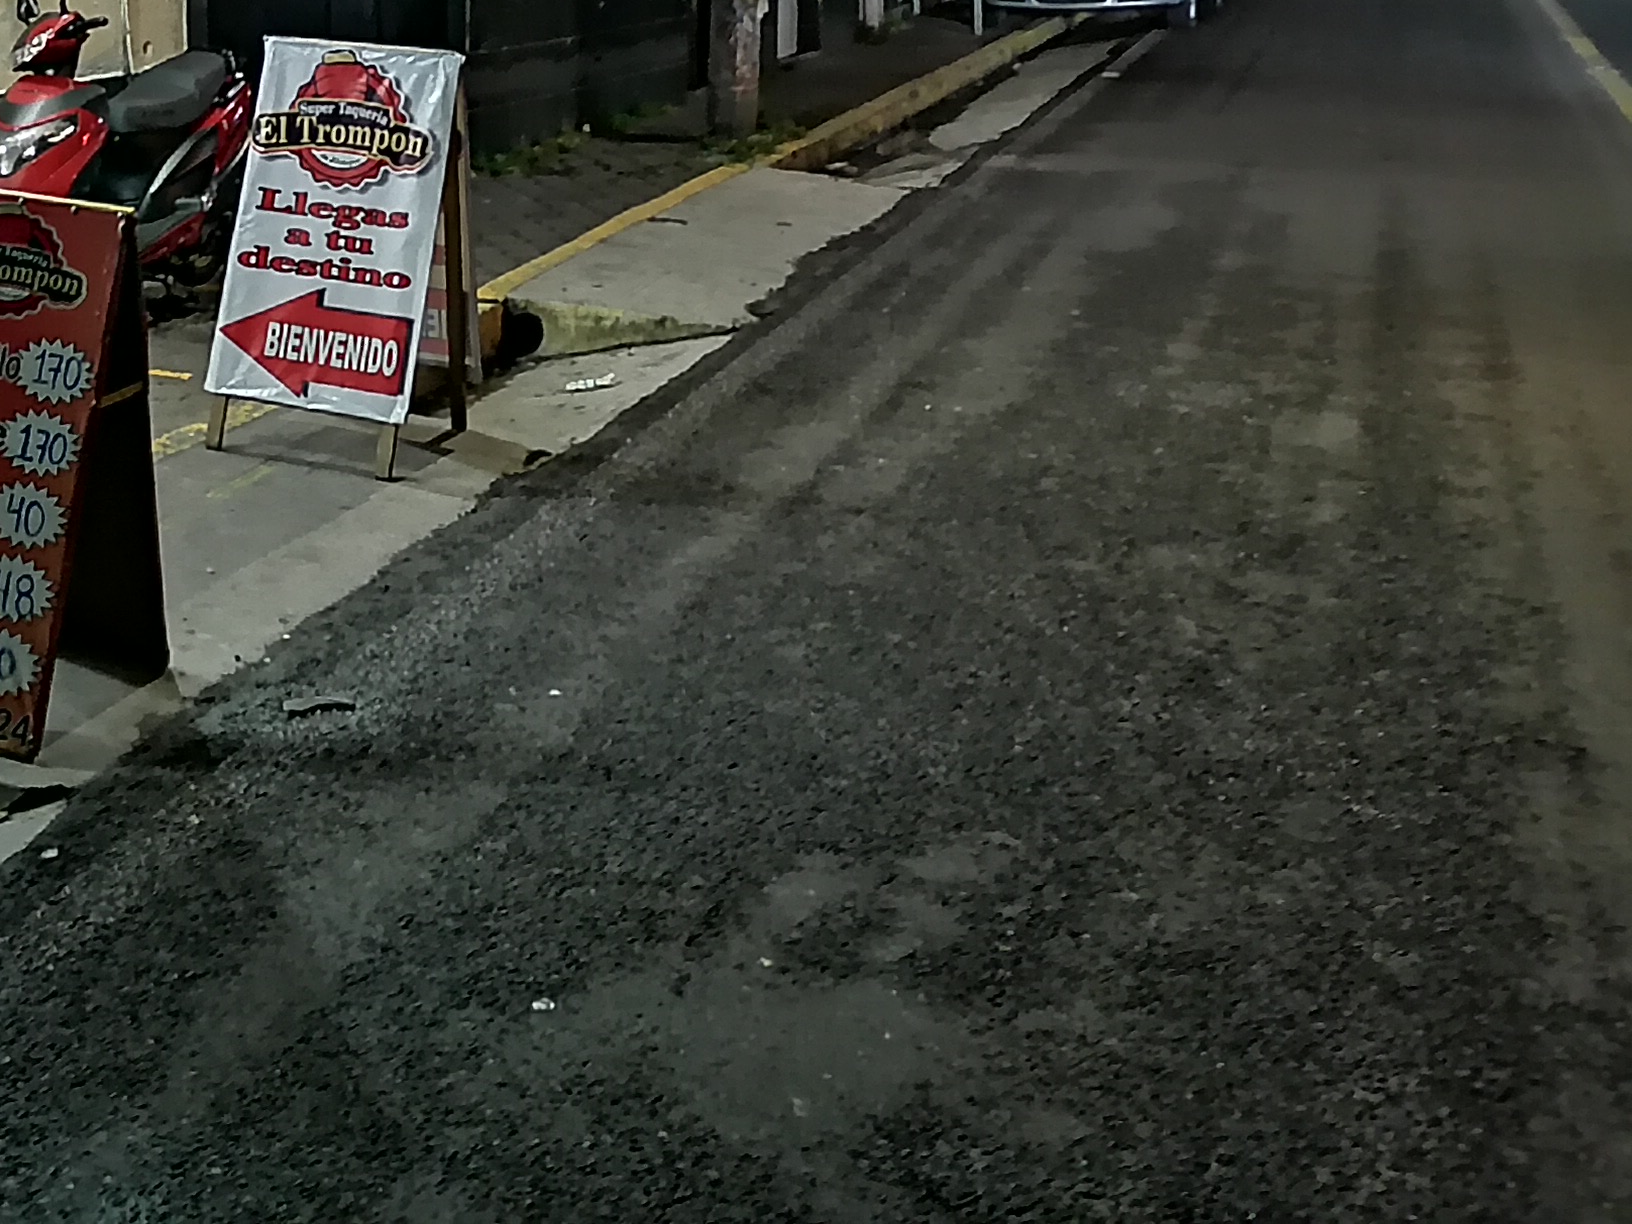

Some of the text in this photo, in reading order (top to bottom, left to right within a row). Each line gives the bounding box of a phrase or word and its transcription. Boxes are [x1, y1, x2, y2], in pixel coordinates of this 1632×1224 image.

[298, 102, 336, 117] Super
[258, 115, 423, 157] El Trompon
[255, 187, 409, 230] Llegas
[284, 227, 374, 255] a tu
[237, 245, 412, 291] destino
[34, 350, 82, 388] 170
[263, 321, 399, 377] BIENVENIDO
[14, 423, 68, 464] 170
[6, 494, 45, 536] 40
